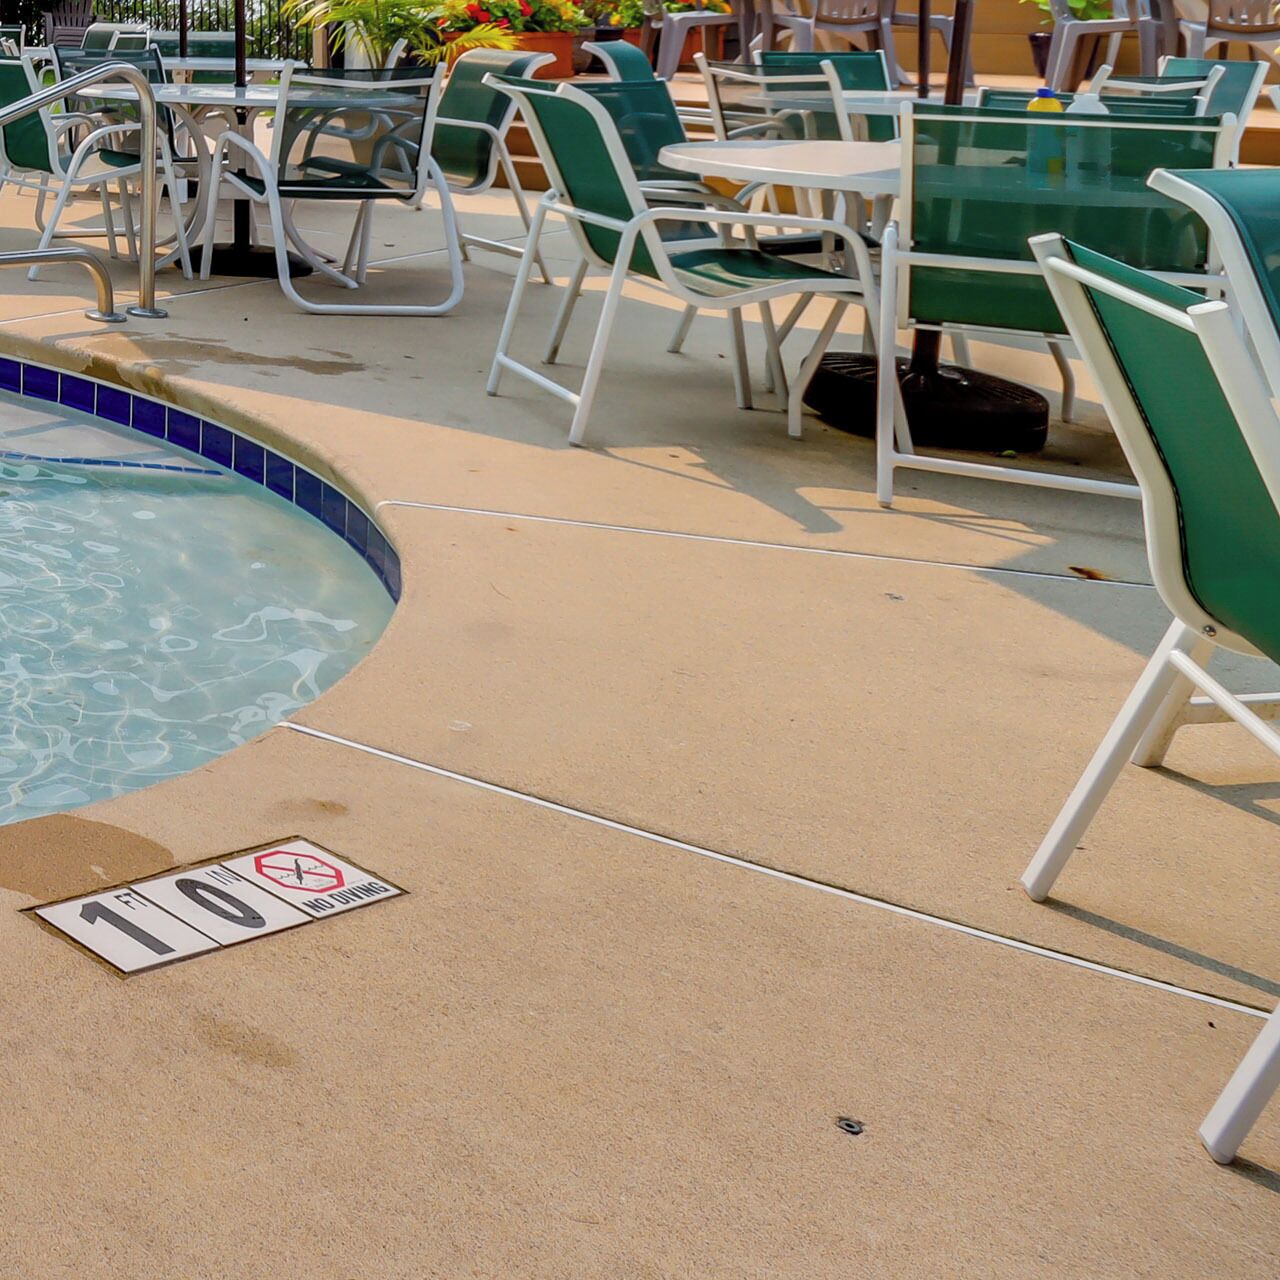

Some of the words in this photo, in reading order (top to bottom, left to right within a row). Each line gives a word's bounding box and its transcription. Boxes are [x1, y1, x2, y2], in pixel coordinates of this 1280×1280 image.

[206, 867, 243, 887] IN
[114, 892, 149, 911] FT
[174, 877, 267, 929] 0
[302, 898, 335, 913] NO
[328, 882, 391, 905] DIVING
[78, 900, 177, 956] 1
